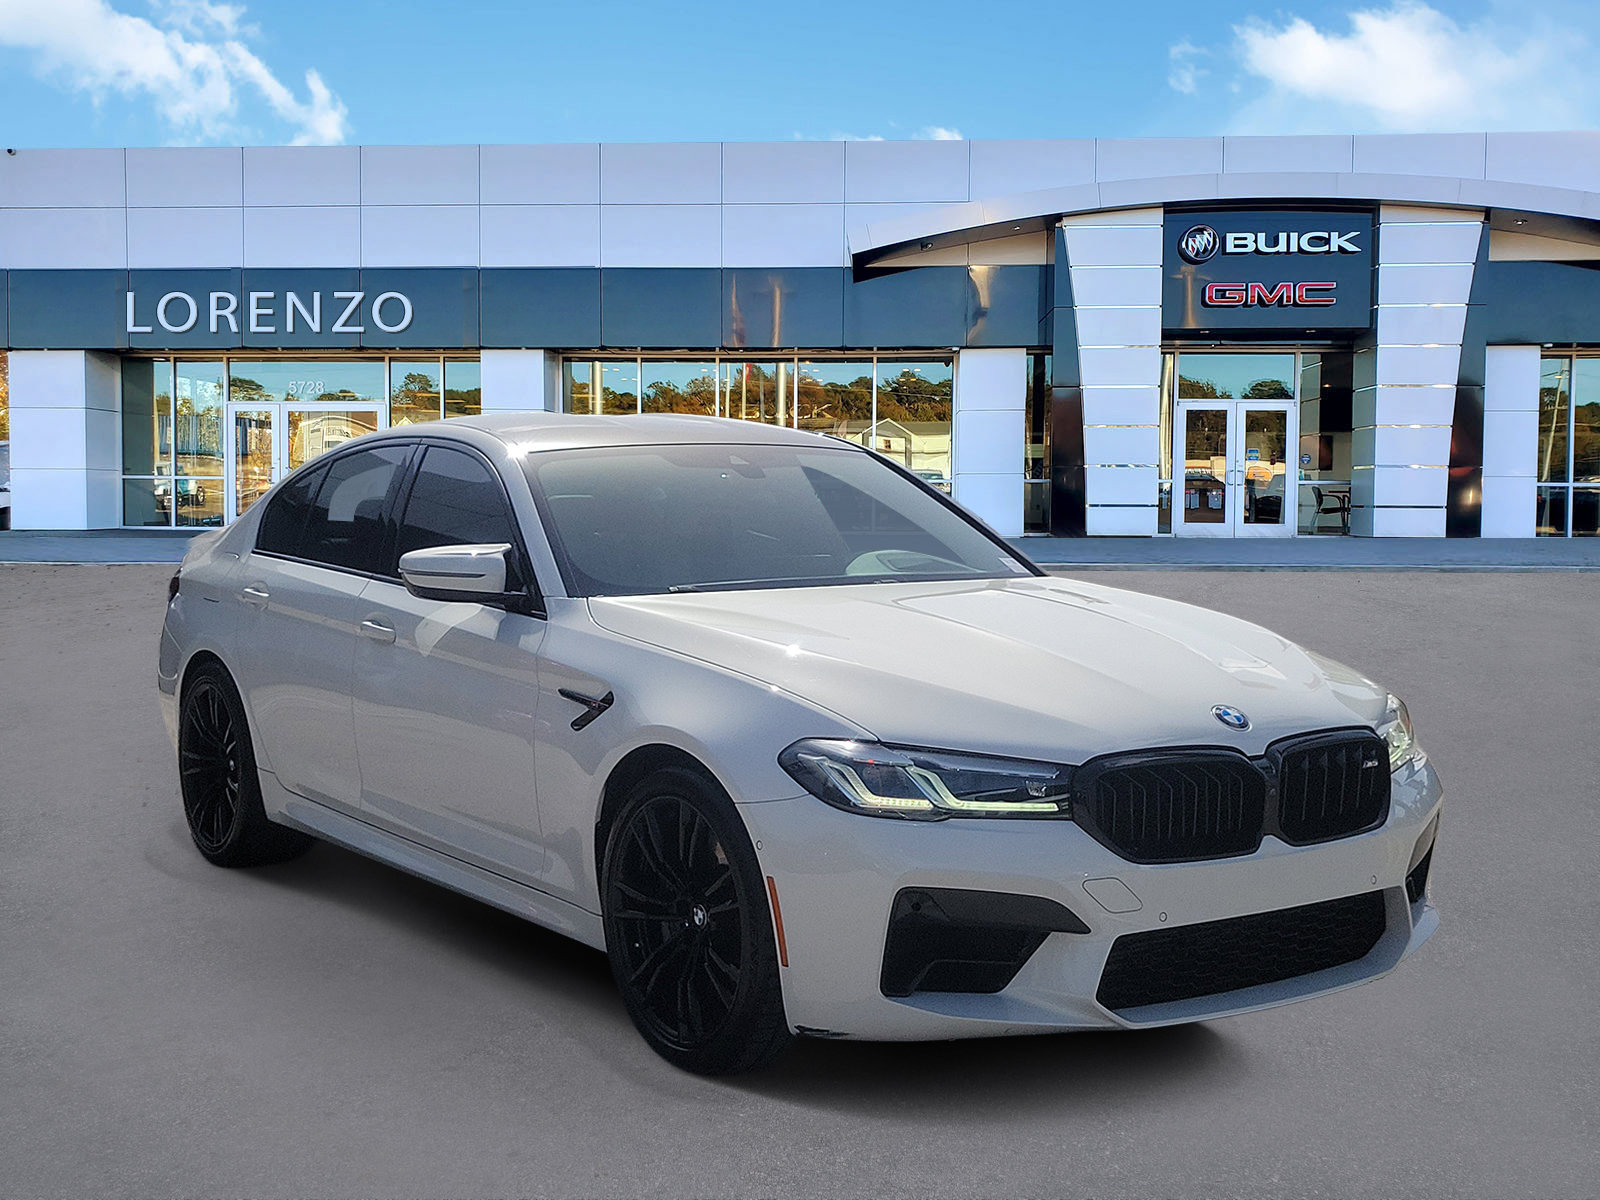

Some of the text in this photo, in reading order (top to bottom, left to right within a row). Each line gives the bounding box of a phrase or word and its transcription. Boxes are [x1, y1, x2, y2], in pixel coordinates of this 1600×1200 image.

[1226, 231, 1362, 253] BUICK
[1205, 281, 1337, 305] GMC
[126, 291, 414, 333] LORENZO
[288, 380, 325, 394] 5728
[738, 403, 833, 419] BUCK
